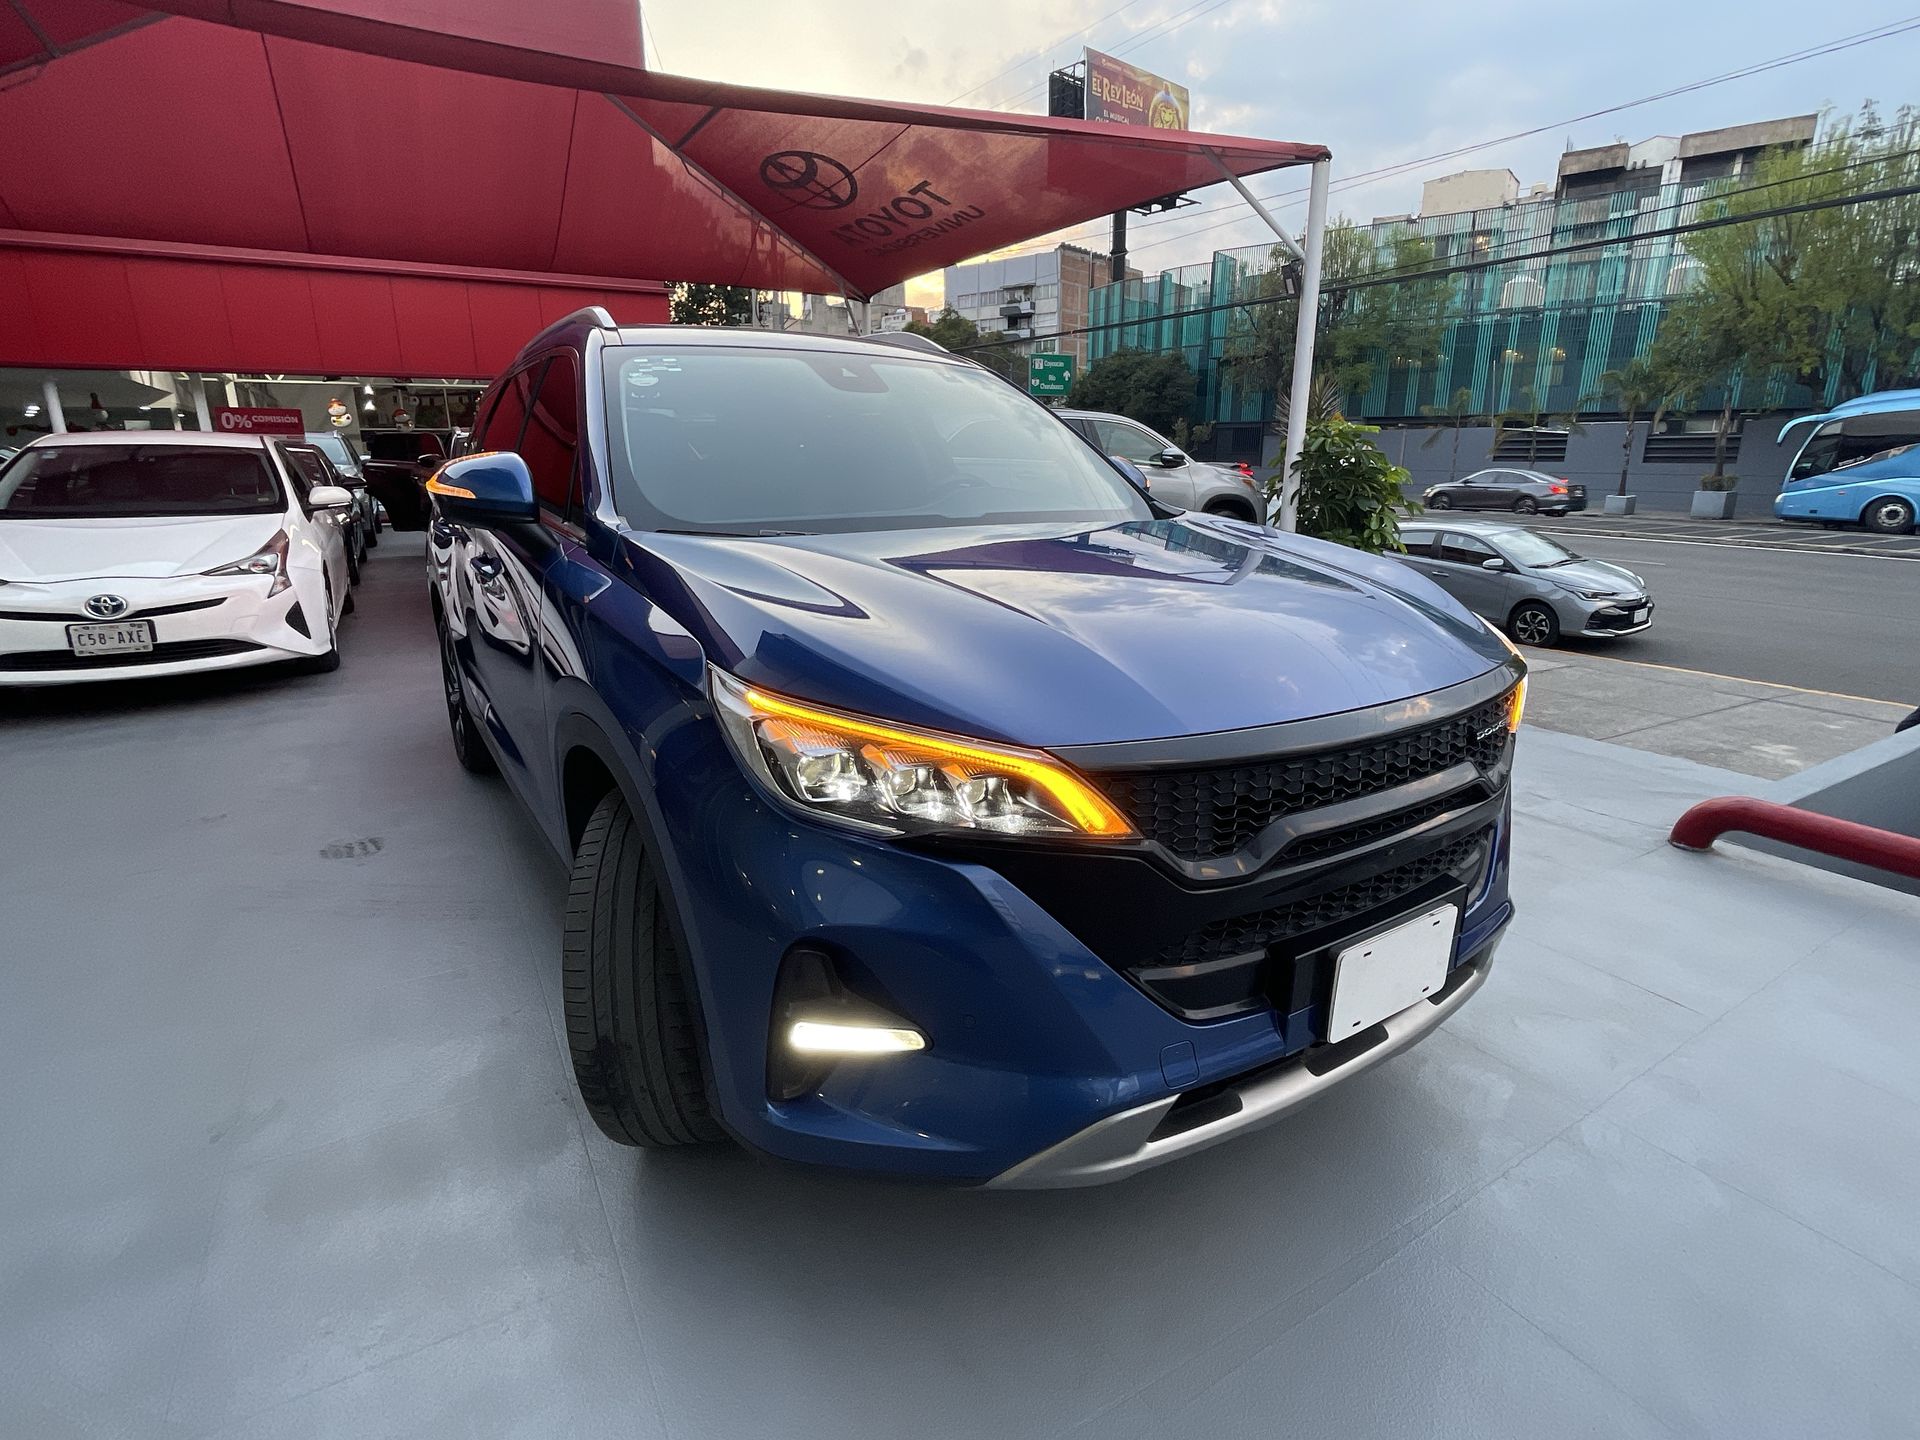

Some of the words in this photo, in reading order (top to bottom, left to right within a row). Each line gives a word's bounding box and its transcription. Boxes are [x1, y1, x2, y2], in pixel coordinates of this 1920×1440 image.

[221, 412, 252, 429] 0%
[252, 415, 298, 423] COMISIÓN
[77, 630, 145, 646] C58-AXE
